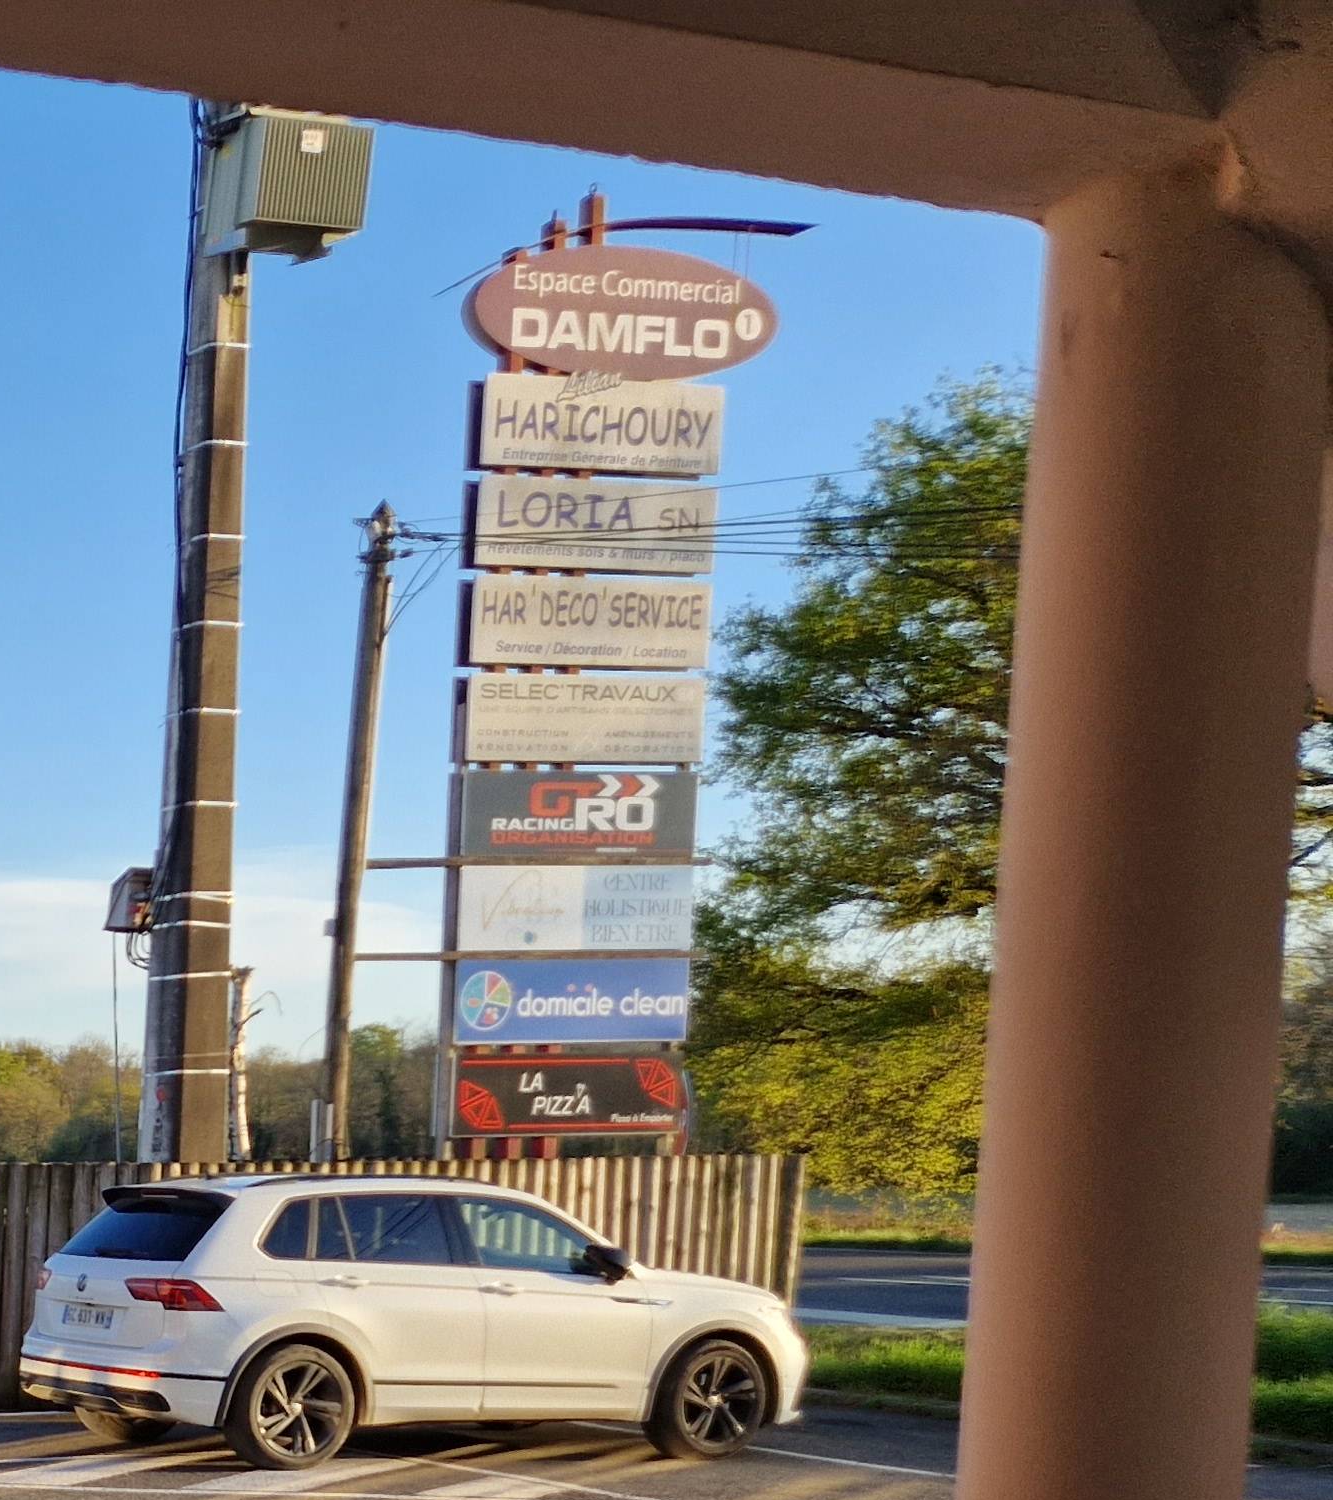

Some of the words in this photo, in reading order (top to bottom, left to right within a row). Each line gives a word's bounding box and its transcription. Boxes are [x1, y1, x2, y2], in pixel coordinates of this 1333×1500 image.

[513, 264, 597, 298] Espace
[601, 270, 741, 304] Commercial
[511, 308, 731, 359] DAMFLO
[495, 399, 713, 449] HARICHOURY
[502, 448, 568, 463] Entreprise
[630, 454, 646, 466] de
[649, 455, 702, 469] Peinture
[497, 490, 634, 531] LORIA
[495, 640, 544, 655] Service
[634, 644, 687, 659] Location
[490, 831, 656, 846] ORGANISATION
[491, 818, 574, 831] RACING
[517, 983, 614, 1017] domicile
[620, 988, 685, 1017] clean
[518, 1071, 544, 1093] LA
